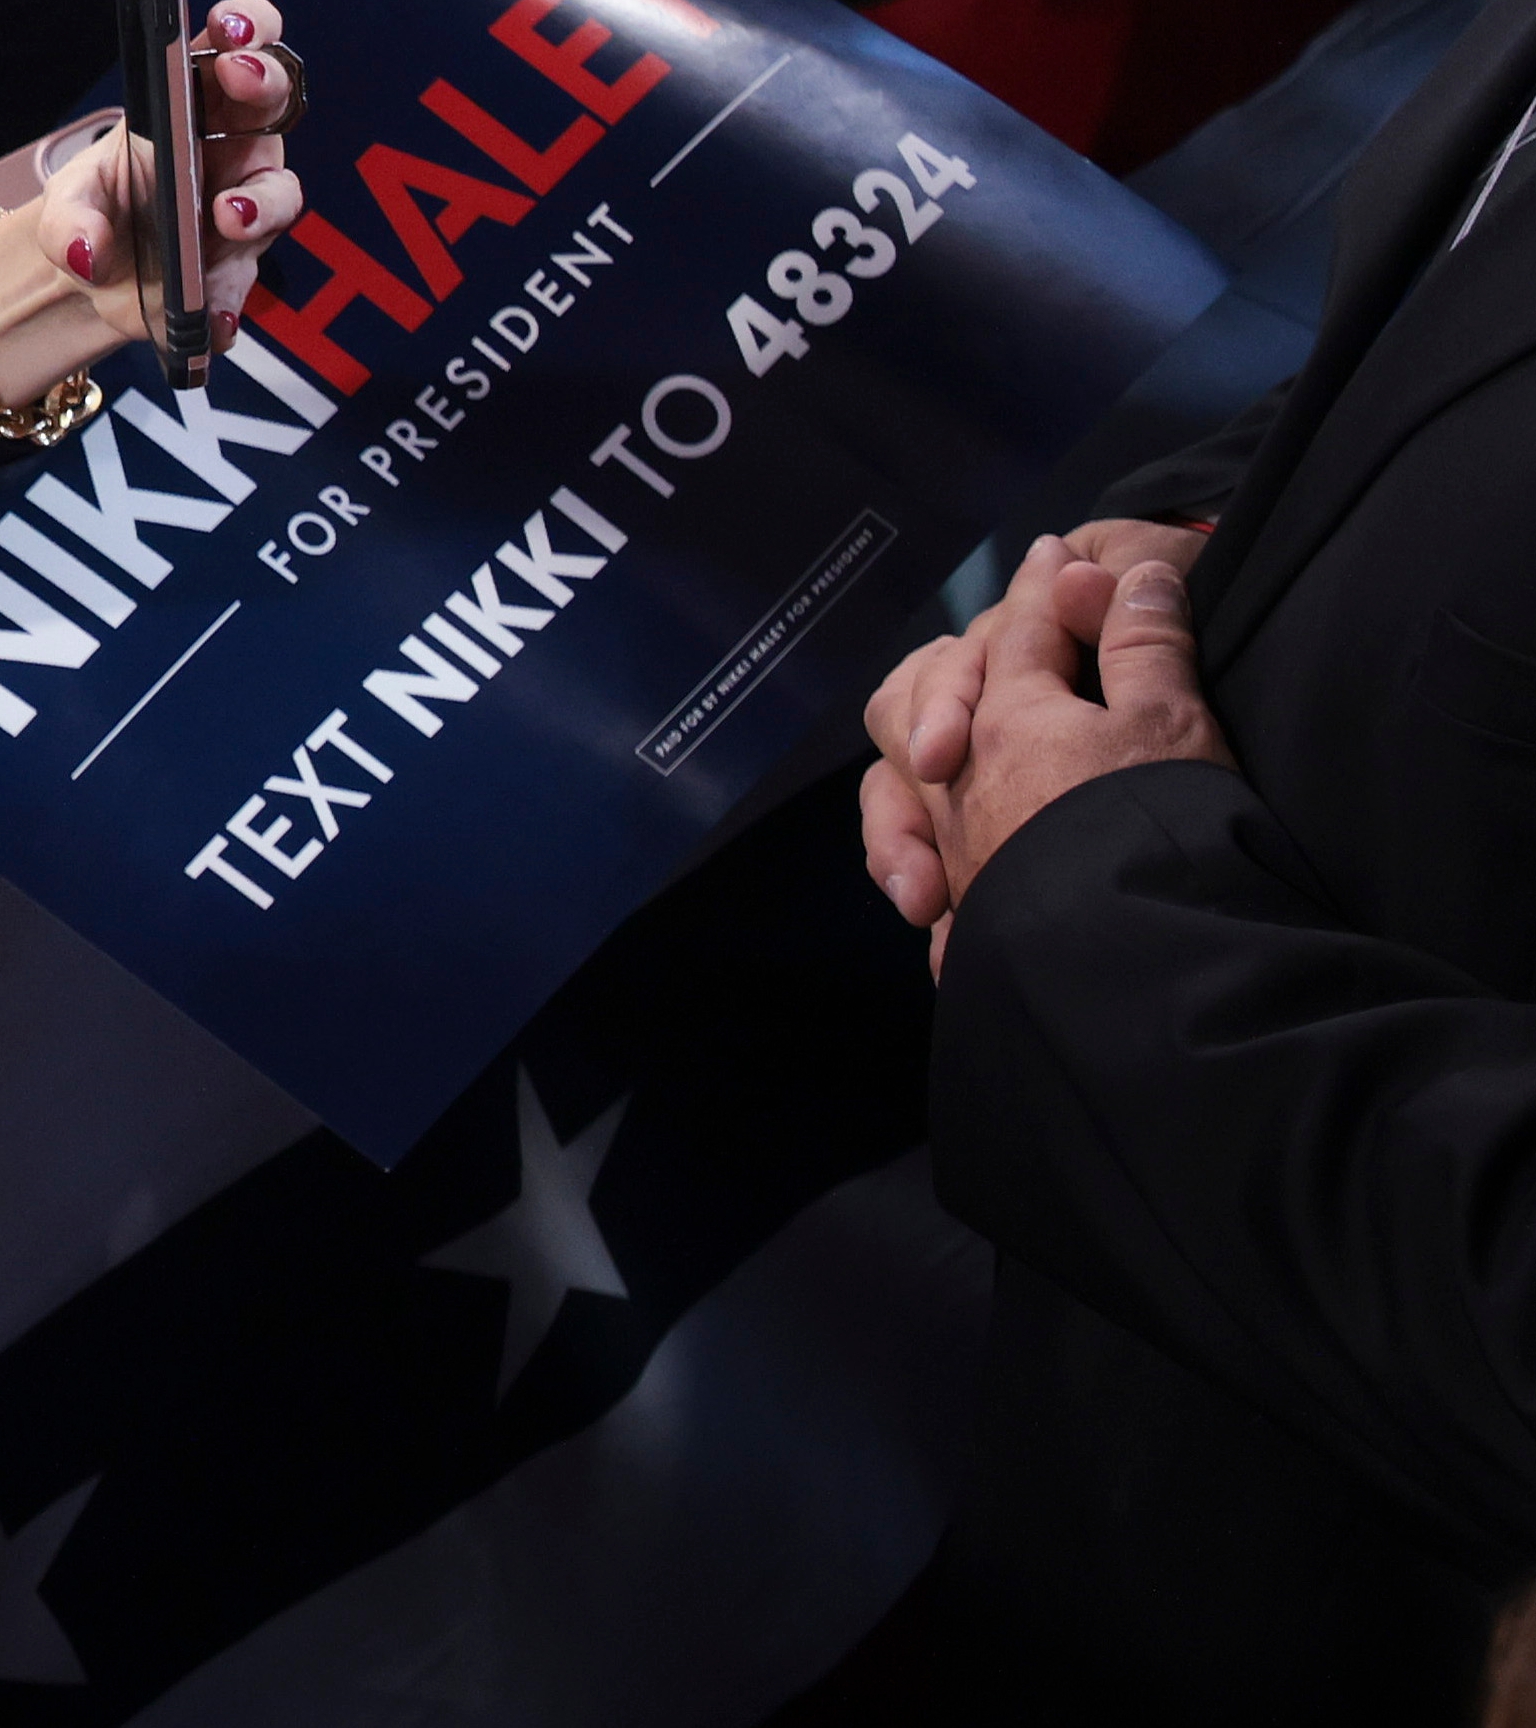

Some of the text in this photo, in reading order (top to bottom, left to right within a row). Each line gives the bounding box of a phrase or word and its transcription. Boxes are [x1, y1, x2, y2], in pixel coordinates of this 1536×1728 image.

[185, 131, 978, 910] TEXT NIKKI TO 48324
[258, 203, 633, 584] FOR PRESIDENT
[654, 527, 874, 759] PAID FOR BY NIKKI HALEY FOR PRESIDENT
